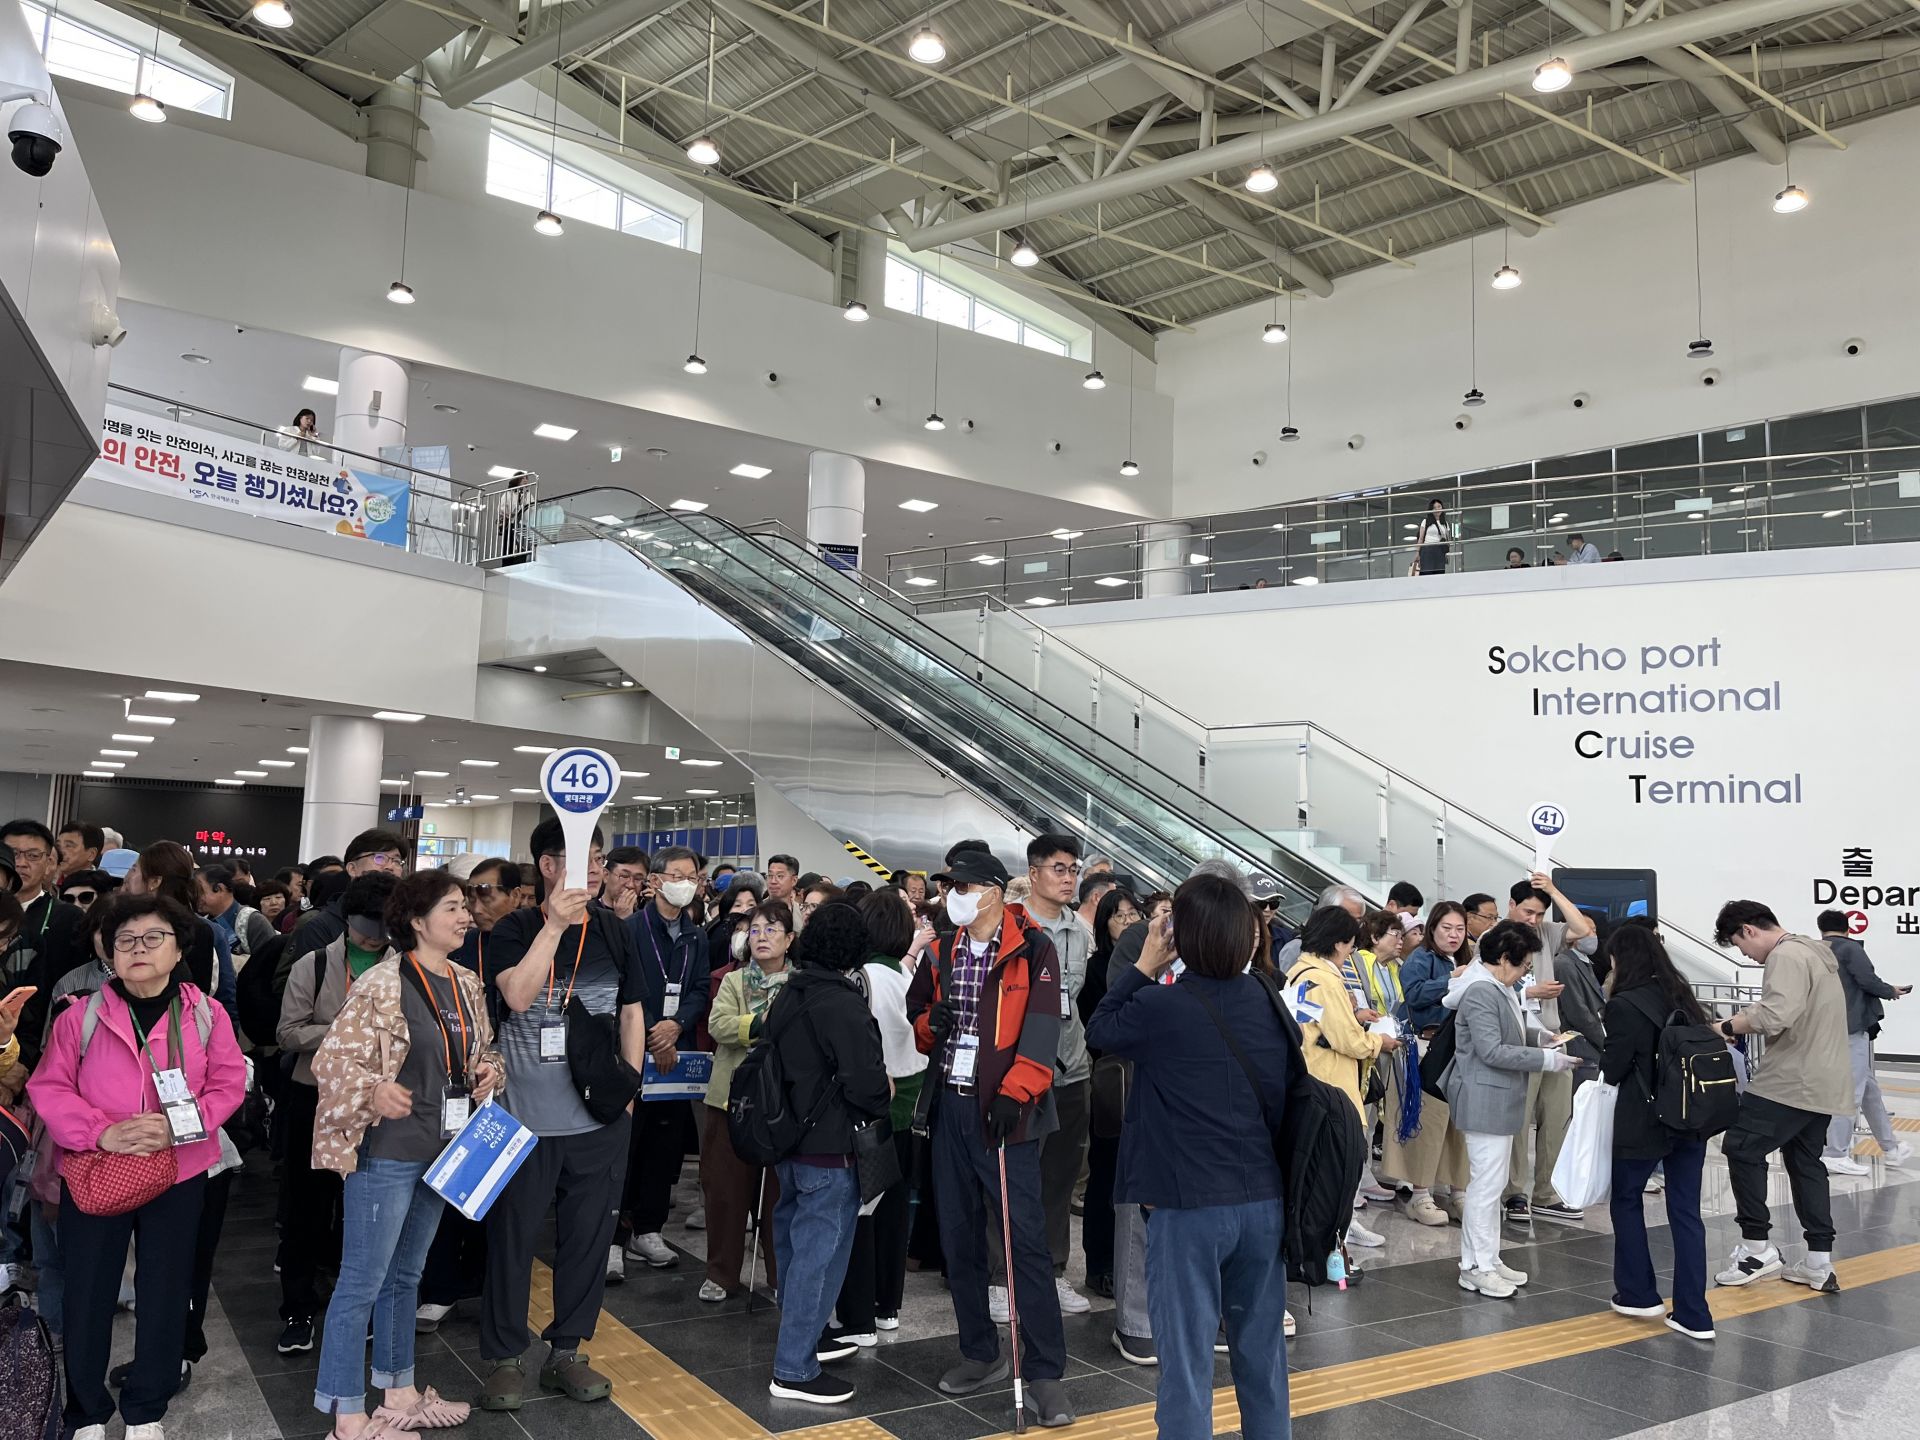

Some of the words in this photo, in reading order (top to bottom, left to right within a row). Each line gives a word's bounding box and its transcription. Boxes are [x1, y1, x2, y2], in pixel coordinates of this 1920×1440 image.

[137, 427, 161, 444] 잇는
[166, 435, 218, 460] 안전의식,
[222, 450, 256, 468] 사고를
[260, 459, 282, 475] 끊는
[286, 466, 329, 487] 현장실천
[95, 438, 127, 465] 의
[135, 446, 186, 481] 안전,
[193, 461, 237, 492] 오늘
[244, 473, 359, 517] 챙기셨나요?
[1488, 643, 1627, 675] Sokcho
[1641, 637, 1721, 675] port
[1533, 681, 1780, 715] International
[1574, 730, 1695, 759] Cruise
[561, 763, 598, 788] 46
[1628, 773, 1801, 804] Terminal
[1539, 811, 1557, 825] 41
[195, 831, 232, 845] 마약,
[199, 845, 267, 856] 처벌받습니다
[1842, 847, 1873, 877] 출
[1813, 878, 1920, 909] Depar
[1897, 913, 1920, 934] 出
